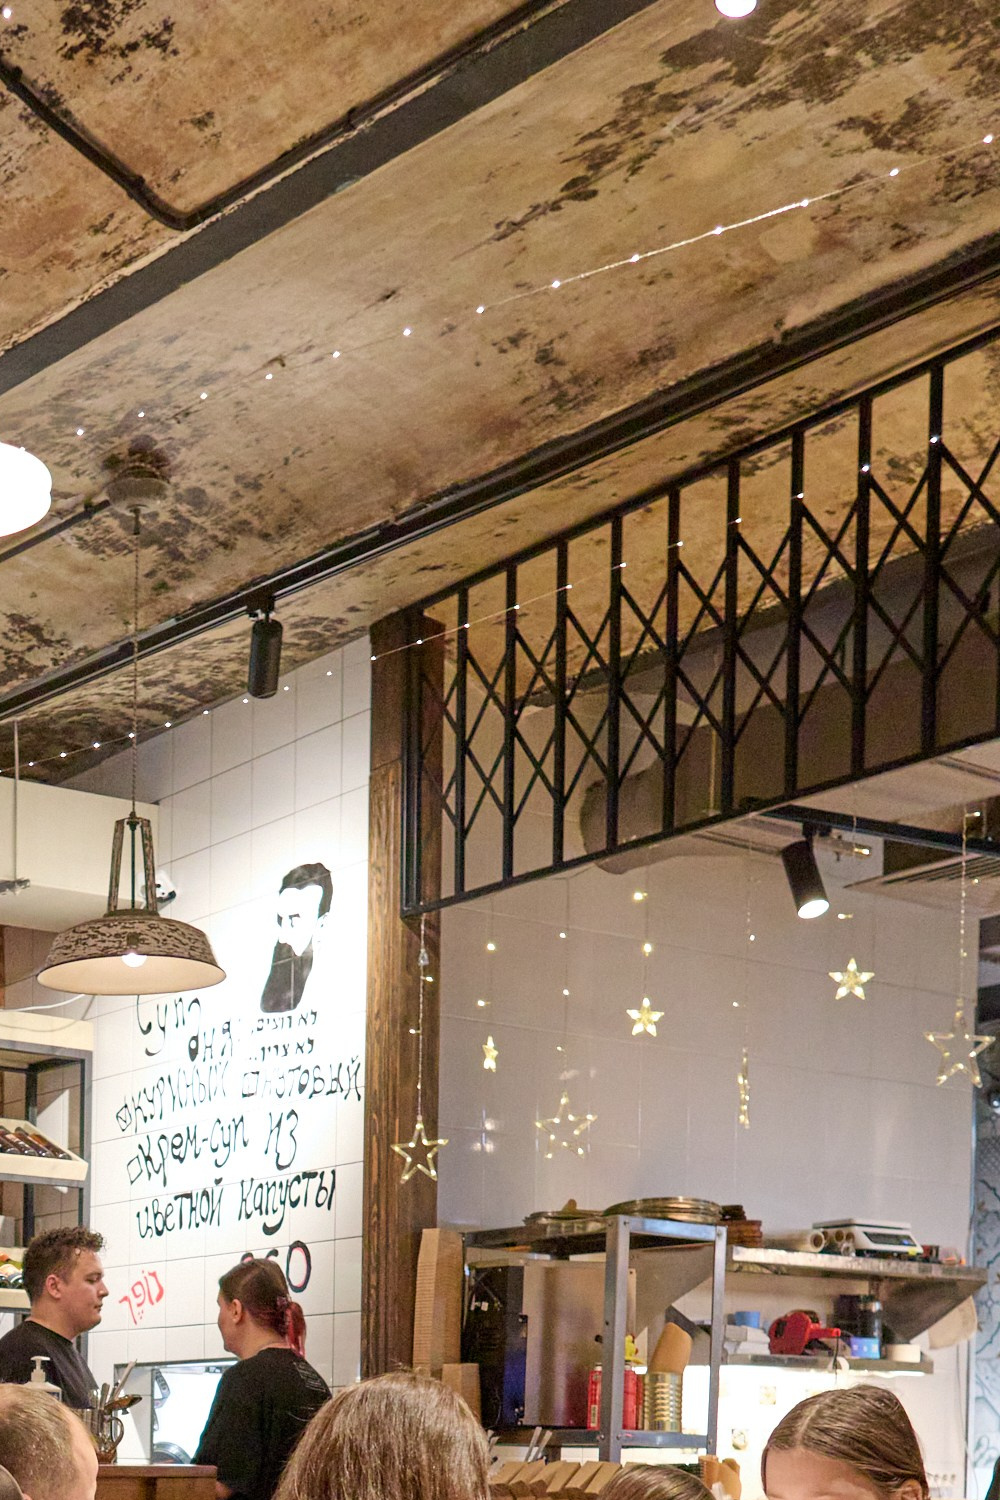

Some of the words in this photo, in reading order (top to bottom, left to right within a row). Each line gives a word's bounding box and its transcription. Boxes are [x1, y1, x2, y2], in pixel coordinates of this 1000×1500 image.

[136, 994, 186, 1057] Суп
[298, 1009, 318, 1026] לא
[295, 1037, 315, 1055] לא
[136, 1177, 223, 1239] цветной
